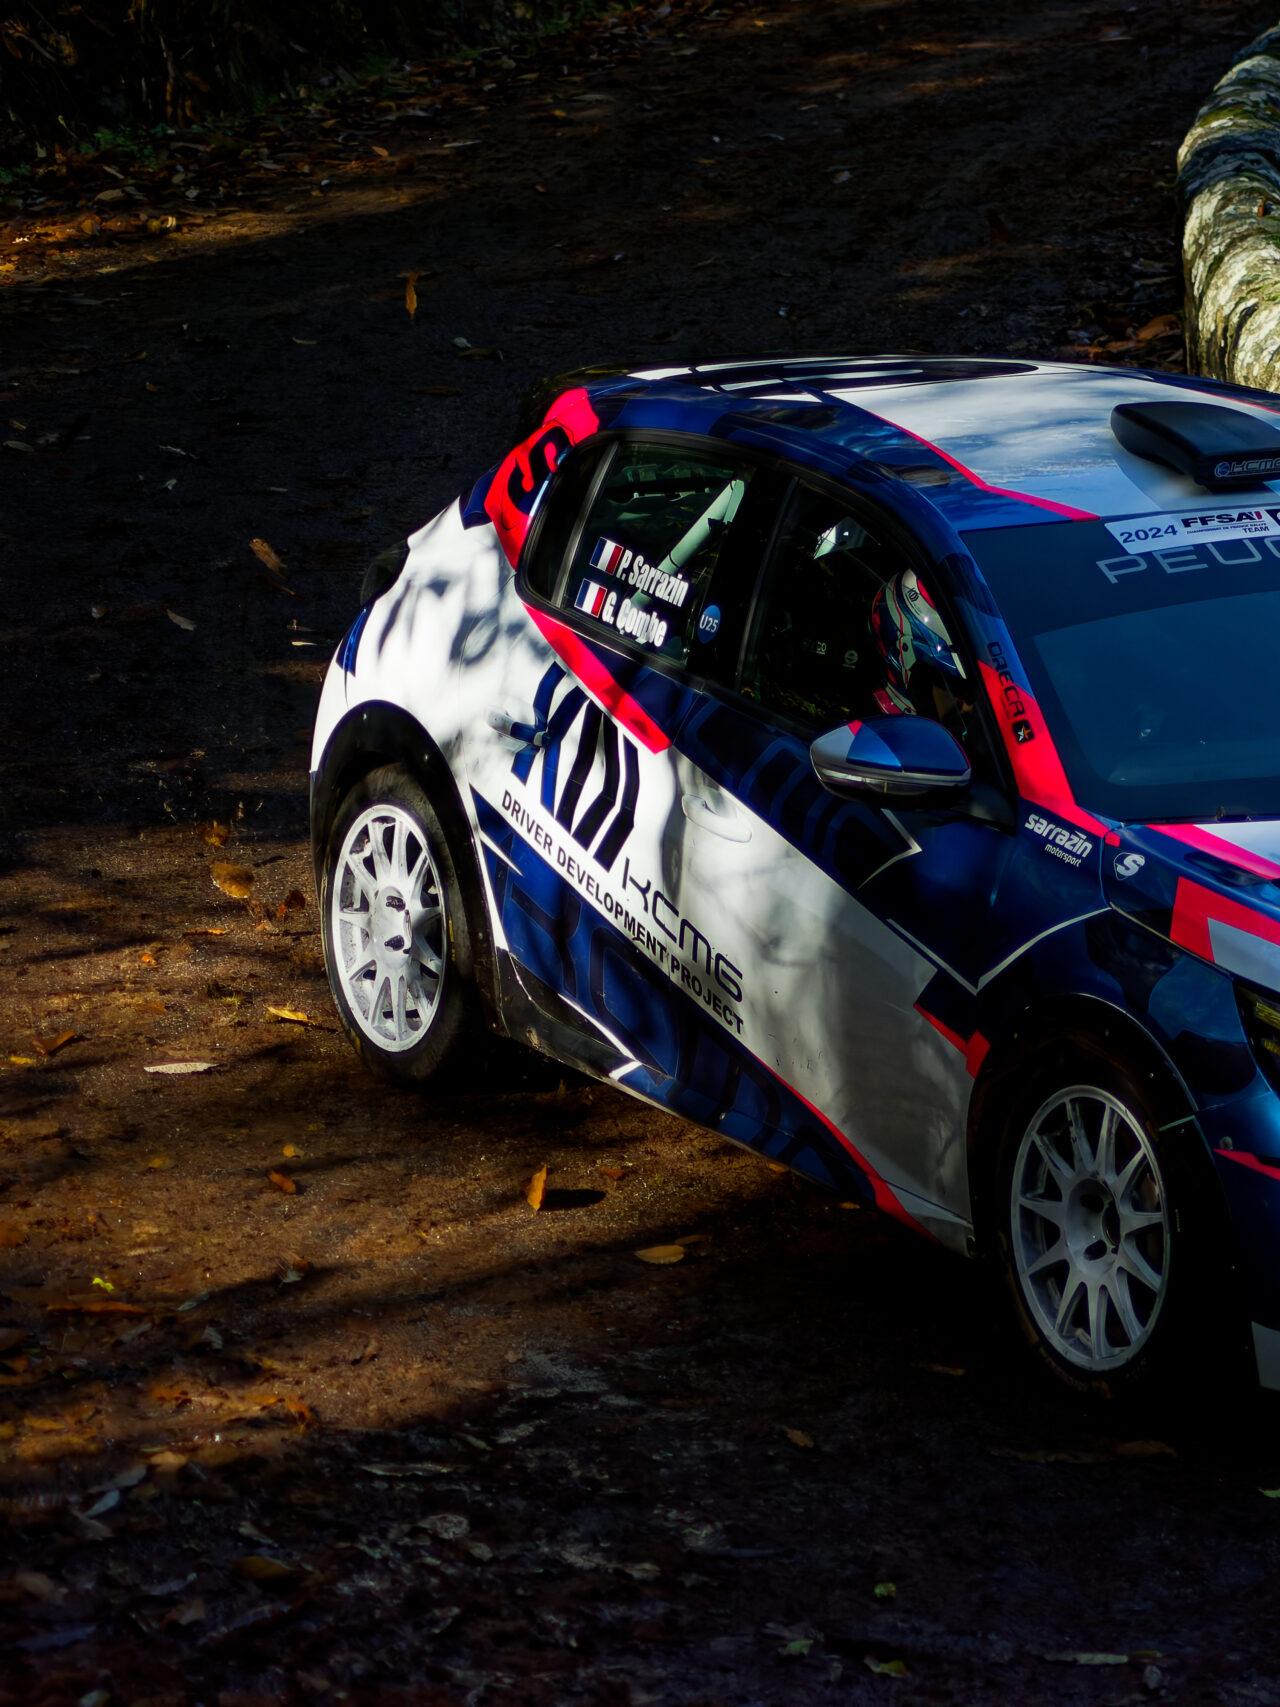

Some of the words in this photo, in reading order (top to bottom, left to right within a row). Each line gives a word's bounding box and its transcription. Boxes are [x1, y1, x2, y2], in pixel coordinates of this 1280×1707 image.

[1120, 524, 1178, 543] 2024
[1181, 511, 1262, 528] FFSA
[1243, 526, 1270, 534] TEAM
[616, 550, 632, 581] P.
[628, 555, 689, 608] Sarrazin
[602, 592, 617, 625] G.
[699, 614, 719, 633] U25
[987, 641, 1026, 717] ORECA
[1024, 813, 1093, 858] sarrazin
[1044, 843, 1082, 868] motorsport
[501, 789, 554, 856] DRIVER
[556, 846, 669, 963] DEVELOPMENT
[670, 956, 745, 1035] PROJECT
